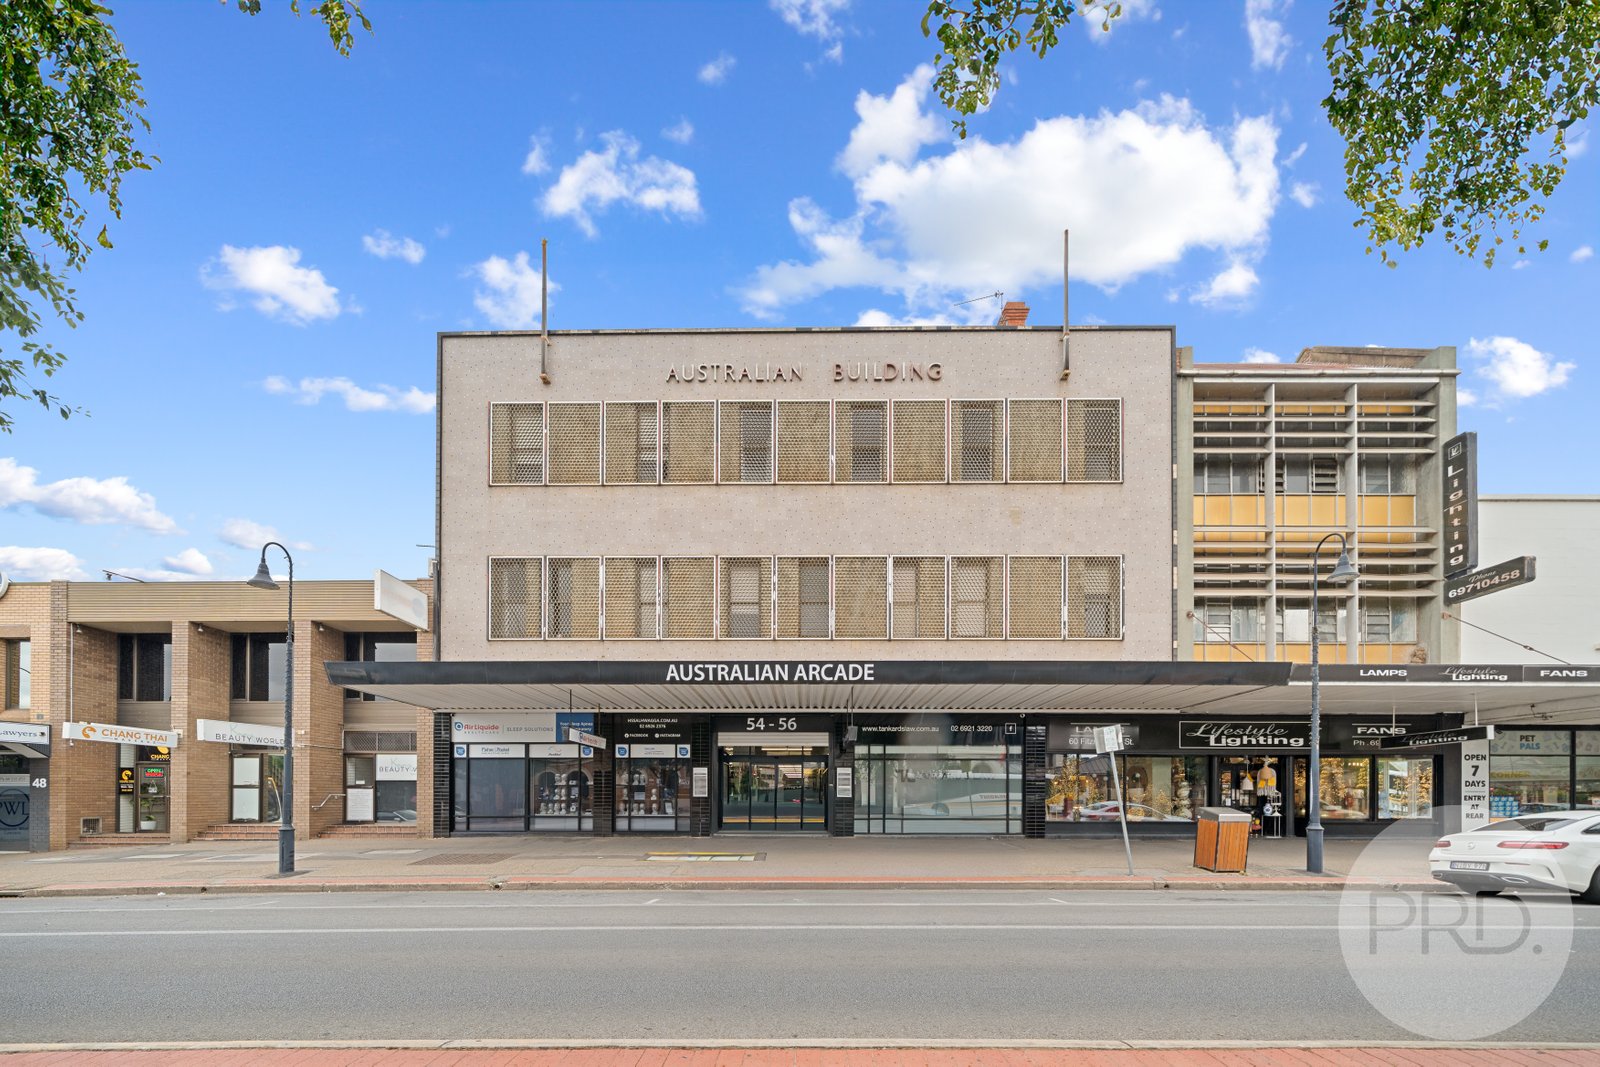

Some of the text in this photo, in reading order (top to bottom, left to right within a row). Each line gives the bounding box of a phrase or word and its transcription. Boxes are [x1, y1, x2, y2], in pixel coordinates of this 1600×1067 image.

[666, 362, 943, 382] AUSTRALIAN BUILDING
[1447, 465, 1464, 566] Lighting
[1448, 569, 1521, 598] 69710458
[666, 664, 875, 681] AUSTRALIAN ARCADE
[1359, 668, 1408, 677] LAMPS
[1452, 673, 1508, 682] Lighting
[1540, 668, 1589, 677] FANS
[746, 718, 766, 731] 54
[778, 718, 797, 731] 56
[861, 725, 940, 733] www.tankardslaw.com.au
[101, 728, 168, 743] CHANG THAI
[1186, 723, 1289, 741] Lifestyle
[1357, 727, 1406, 735] FANS
[215, 733, 252, 743] BEAUTY
[1209, 735, 1305, 748] Lighting
[1519, 743, 1541, 751] PALS
[1471, 765, 1480, 776] 7
[32, 778, 47, 789] 48
[1465, 780, 1486, 788] DAYS
